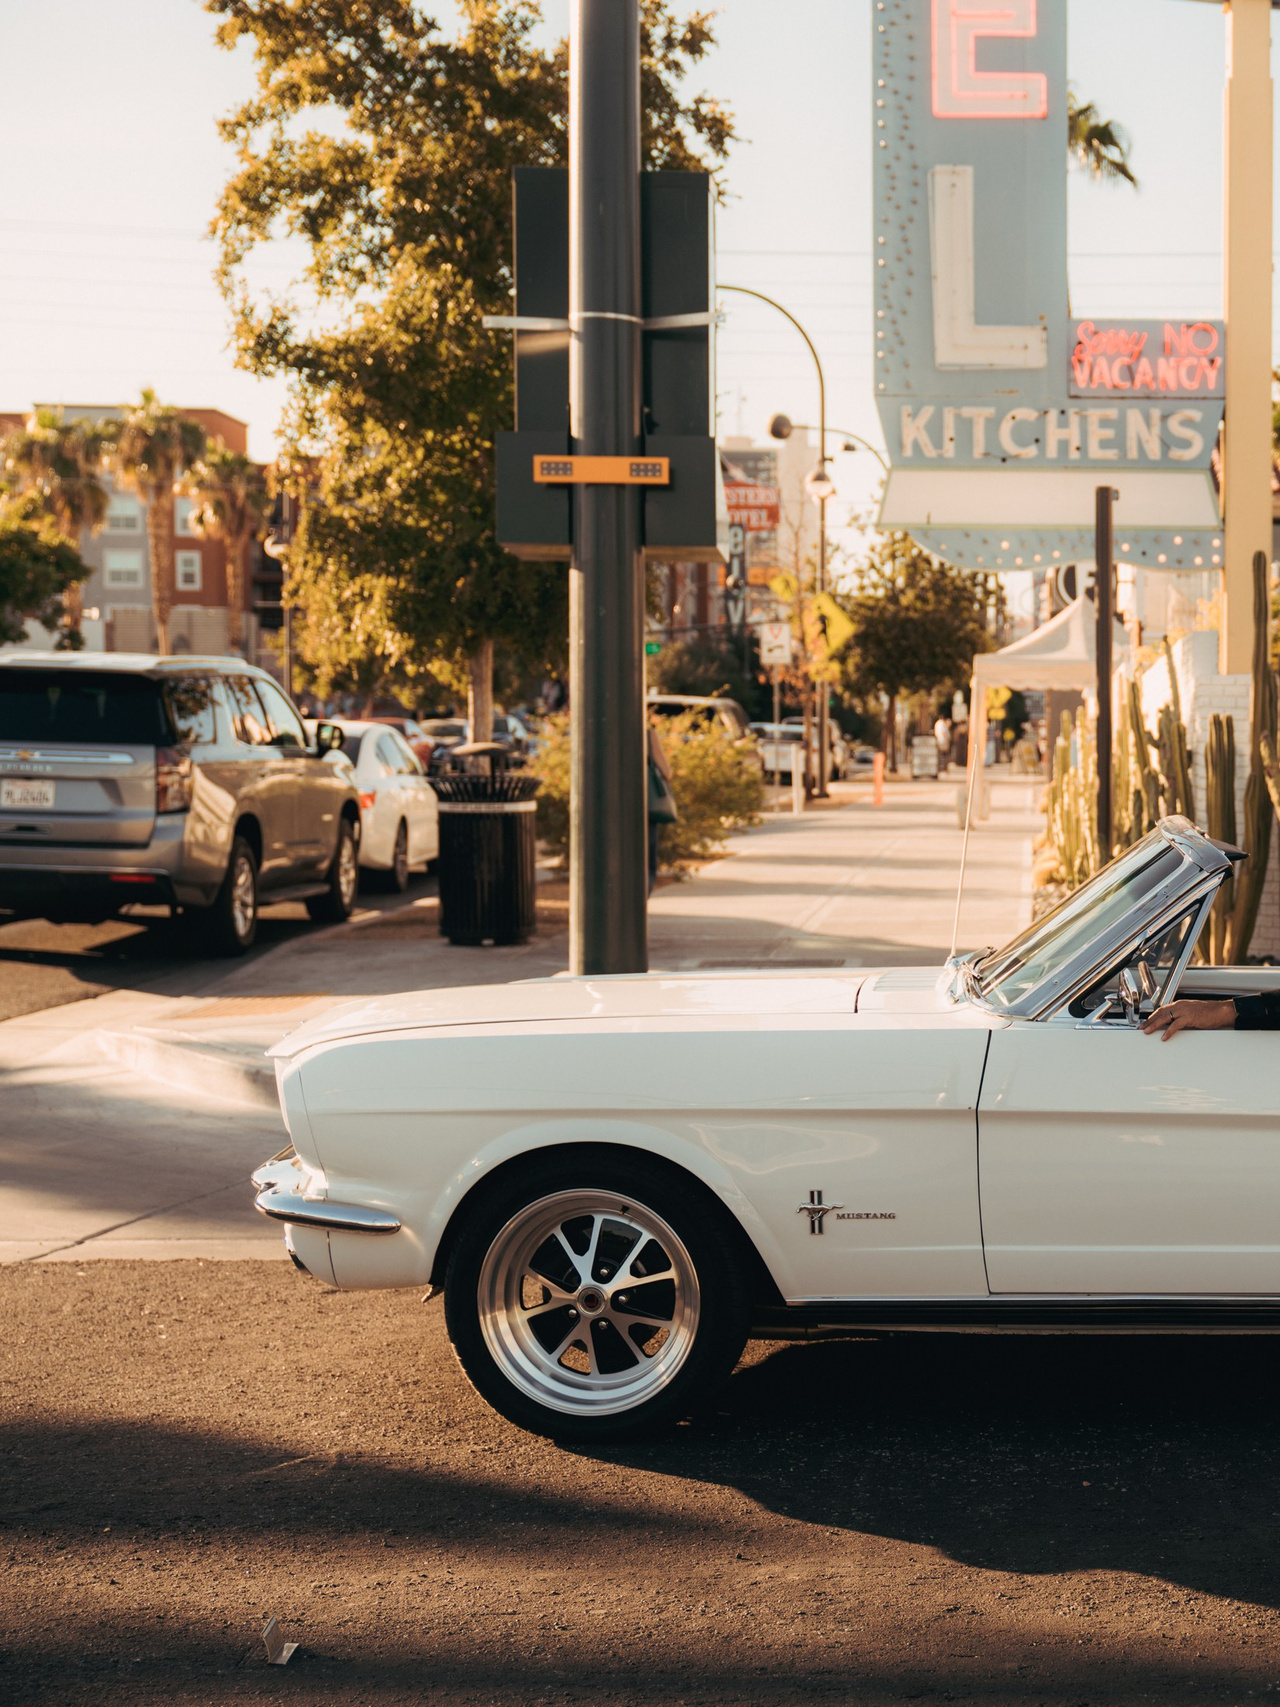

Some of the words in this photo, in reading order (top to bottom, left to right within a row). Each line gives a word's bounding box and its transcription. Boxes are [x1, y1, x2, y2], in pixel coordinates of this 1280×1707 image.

[1074, 320, 1148, 362] Sorry
[1164, 322, 1219, 356] NO
[1071, 356, 1221, 391] VACANCY
[901, 405, 1205, 461] KITCHENS
[836, 1212, 896, 1220] MUSTANG
